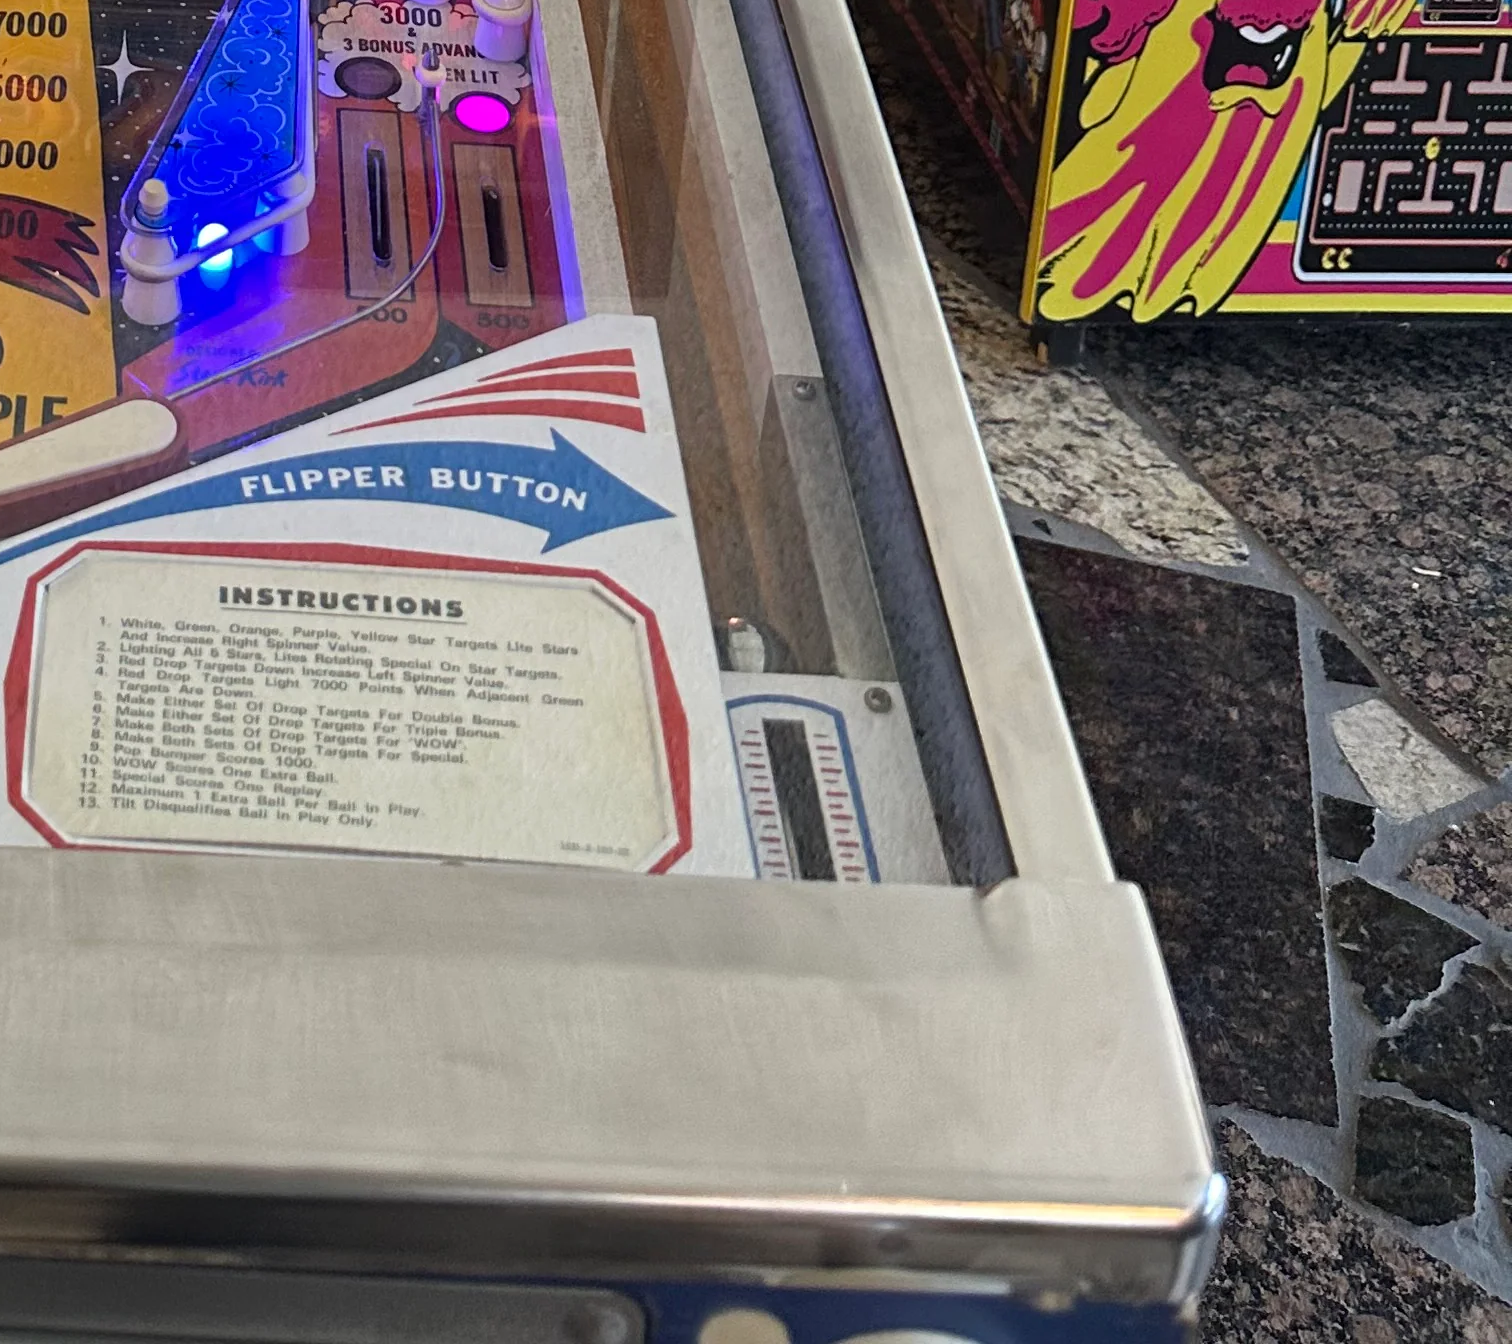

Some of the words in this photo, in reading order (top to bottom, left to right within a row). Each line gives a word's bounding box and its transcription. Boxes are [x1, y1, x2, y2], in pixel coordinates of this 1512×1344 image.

[380, 5, 443, 28] 3000
[344, 38, 353, 52] 3
[359, 39, 416, 55] BONUS
[422, 42, 486, 59] ADVAN
[471, 69, 500, 84] LIT
[478, 313, 530, 331] 500
[240, 465, 405, 498] FLIPPER
[431, 467, 588, 511] BUTTON
[219, 585, 464, 619] INSTRUCTIONS
[351, 630, 398, 643] Yellow
[407, 634, 436, 646] Star
[445, 636, 498, 651] Targets
[507, 640, 533, 653] Lite
[542, 643, 579, 656] Stars
